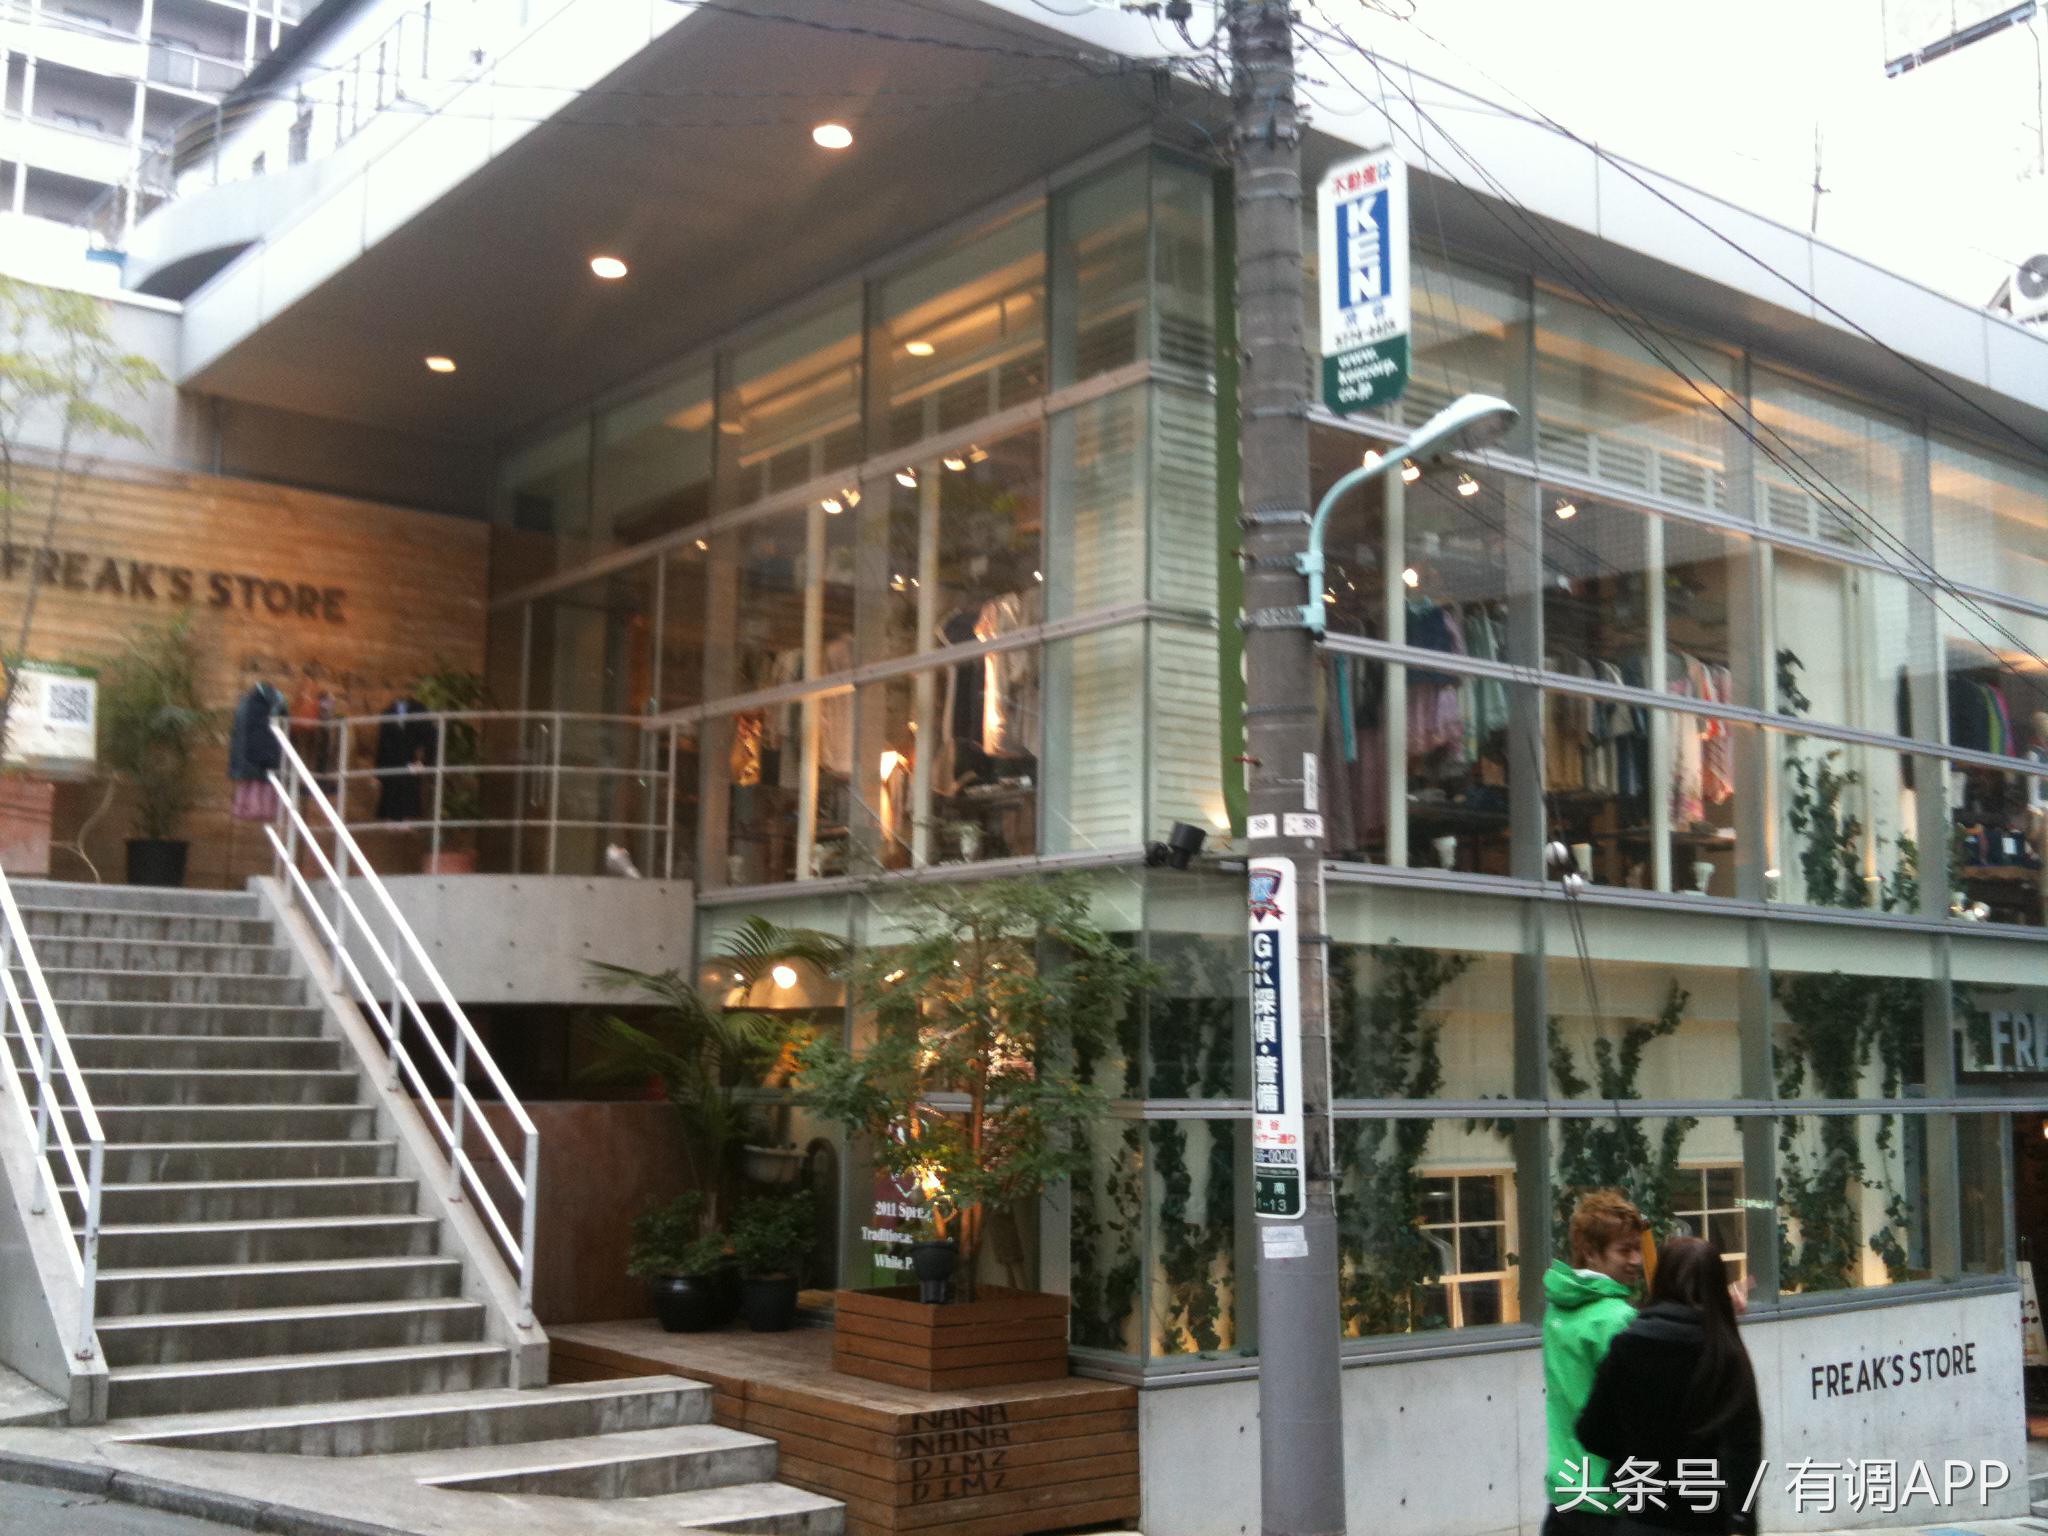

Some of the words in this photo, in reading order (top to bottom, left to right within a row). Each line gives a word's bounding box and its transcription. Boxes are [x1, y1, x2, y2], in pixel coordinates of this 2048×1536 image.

[1348, 194, 1382, 306] KEN
[3, 545, 194, 602] FREAK'S
[208, 570, 348, 625] STORE
[1811, 1354, 1904, 1400] FREAK'S
[1910, 1342, 1977, 1384] STORE
